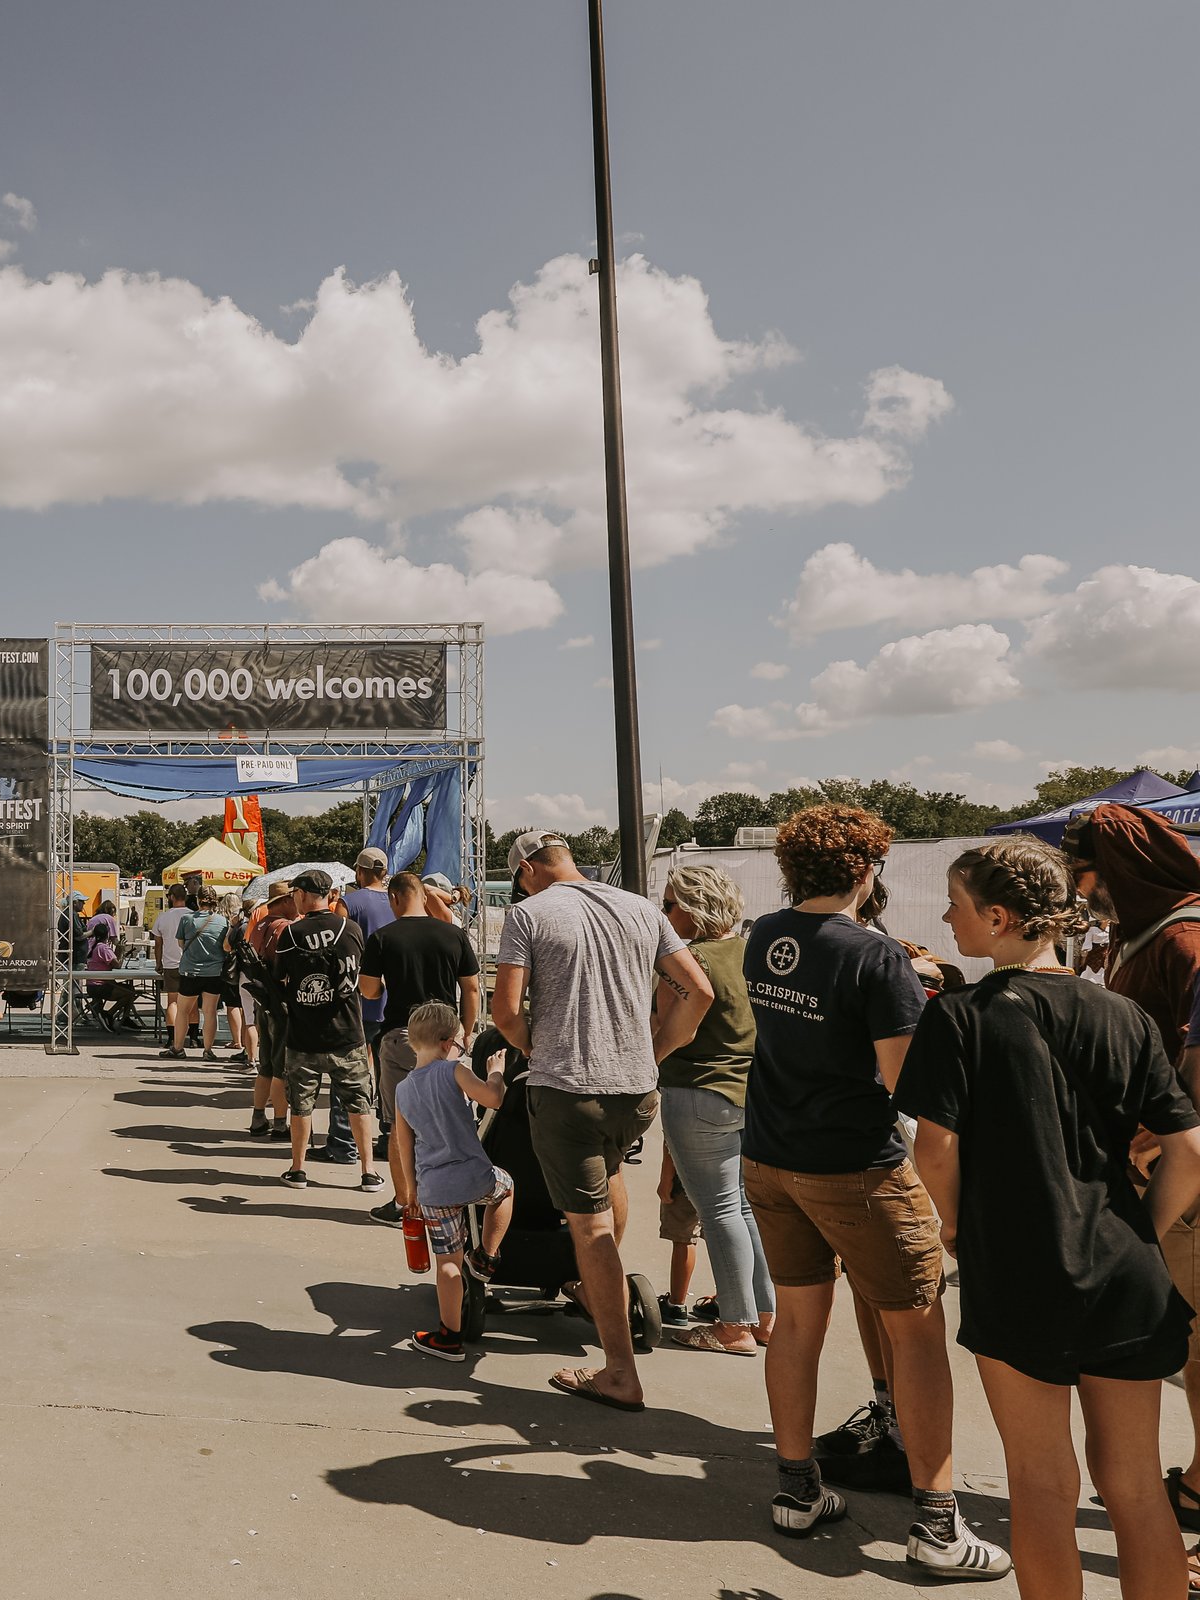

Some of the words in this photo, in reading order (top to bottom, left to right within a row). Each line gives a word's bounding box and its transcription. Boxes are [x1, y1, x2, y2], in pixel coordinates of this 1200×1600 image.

[107, 668, 253, 707] 100,000
[264, 665, 433, 700] welcomes
[241, 760, 274, 769] PRE-PAID
[275, 760, 293, 770] ONLY
[5, 822, 30, 830] SPIRIT
[223, 871, 253, 880] CASH
[305, 929, 335, 949] UP
[9, 959, 38, 967] ARROW
[296, 988, 335, 1003] SCOTFEST
[745, 981, 755, 992] T.
[756, 982, 818, 1008] CRISPIN'S
[770, 1002, 796, 1014] CENTER
[802, 1011, 825, 1022] CAMP
